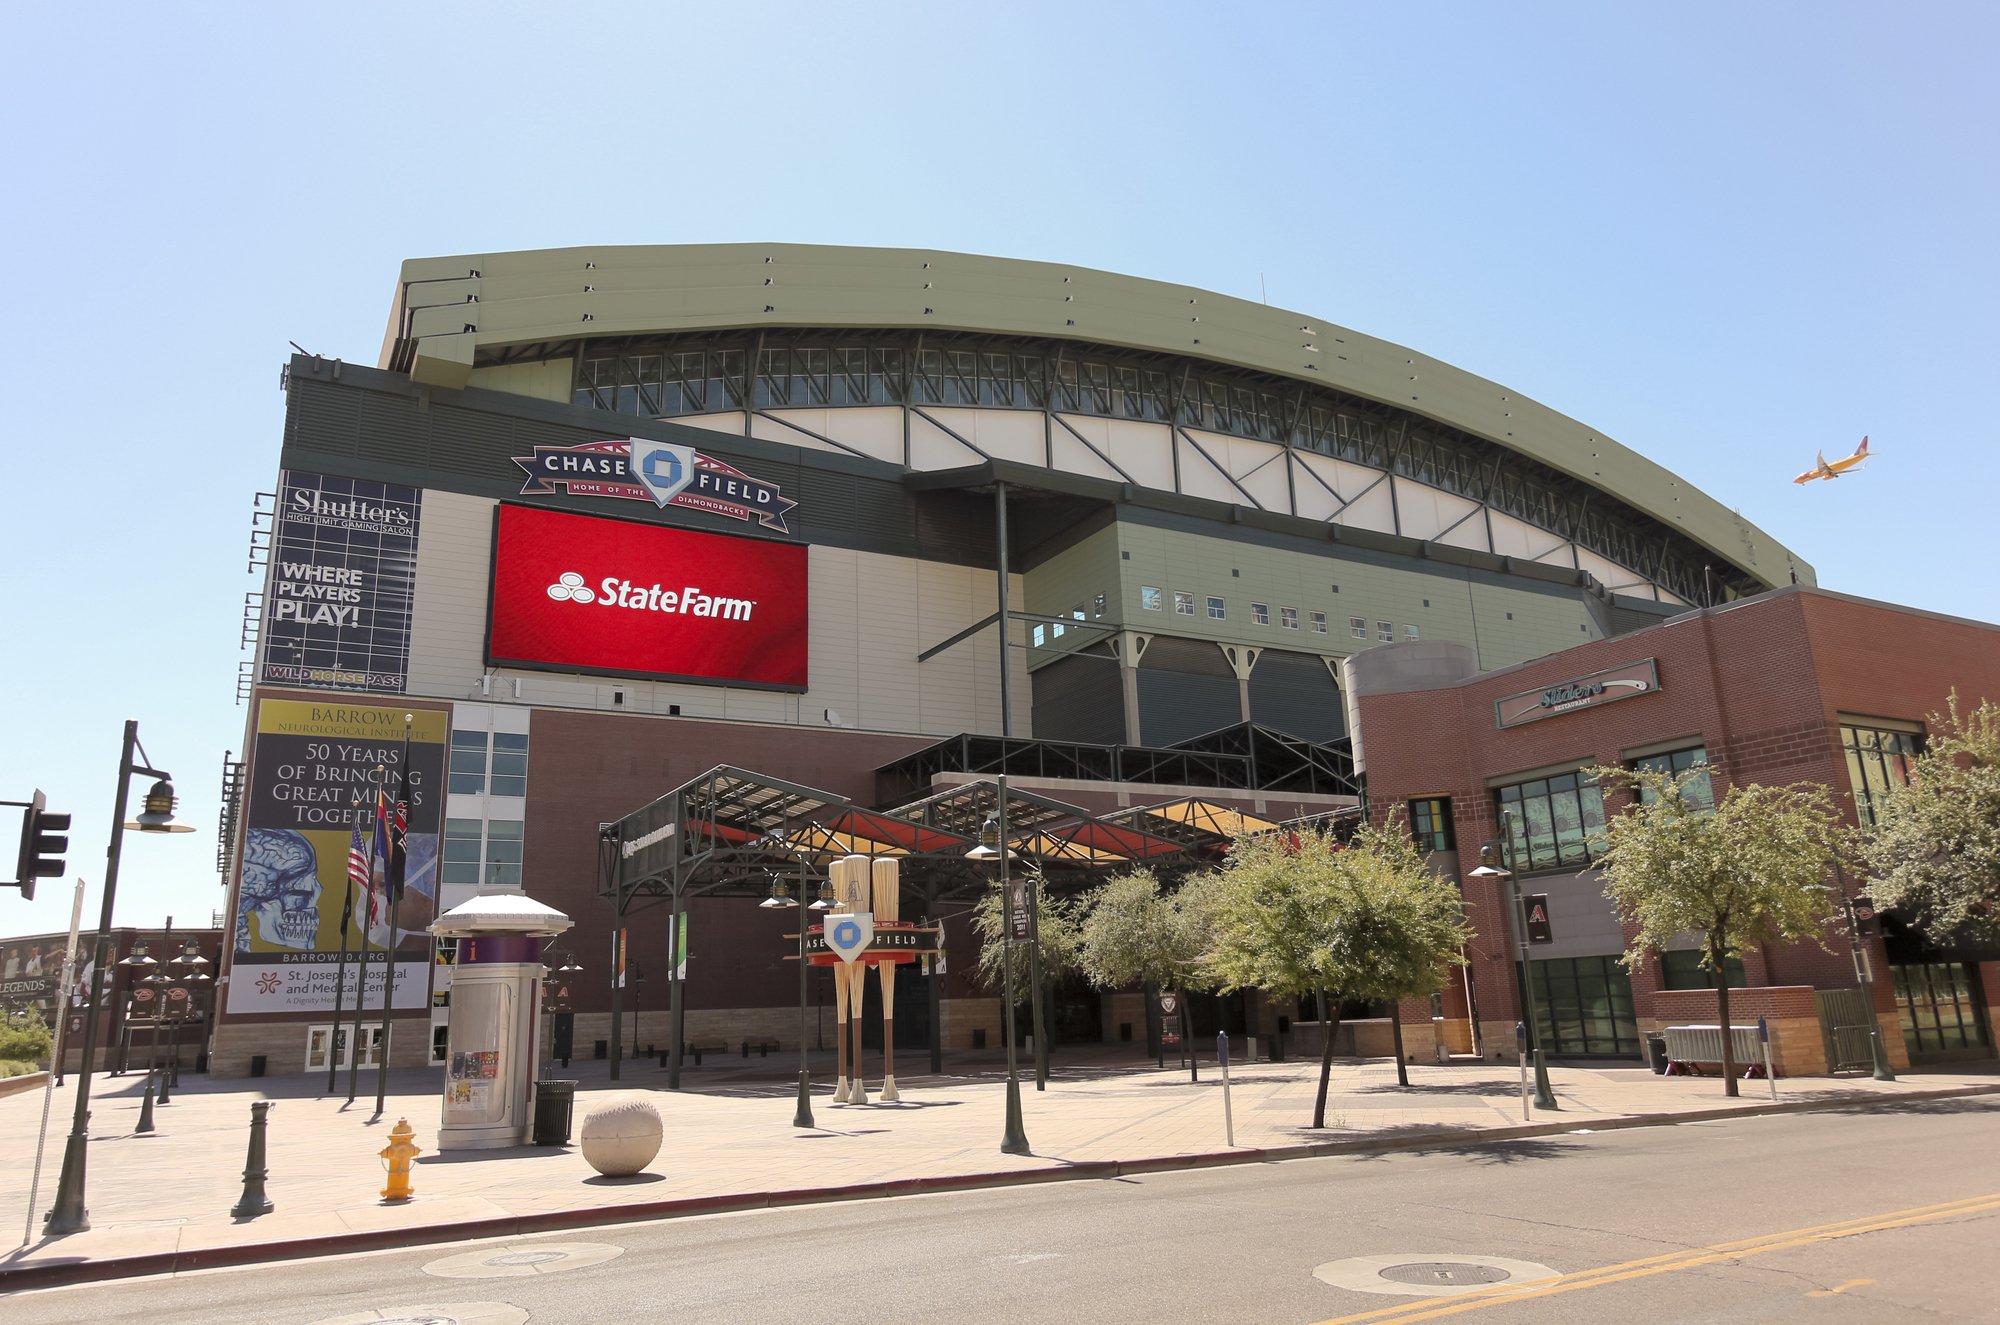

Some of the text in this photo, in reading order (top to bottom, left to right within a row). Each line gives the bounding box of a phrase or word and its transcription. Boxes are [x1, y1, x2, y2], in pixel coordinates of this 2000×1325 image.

[545, 456, 770, 504] CHASE FIELD
[292, 489, 409, 526] Shutter's
[573, 484, 601, 492] HOME
[627, 488, 644, 496] THE
[678, 496, 744, 516] DIAMONDBACKS
[287, 513, 413, 536] HIGH LIMIT GAMING SALON
[282, 562, 363, 586] WHERE
[278, 582, 361, 603] PLAYERS
[276, 599, 359, 629] PLAY!
[1554, 698, 1591, 711] RESTAURANT
[311, 708, 396, 726] BARROW
[278, 723, 366, 738] NEUROLOGICAL
[306, 744, 399, 764] 50 YEARS
[277, 765, 306, 780] OF
[273, 784, 422, 806] GREAT MINS
[293, 805, 394, 825] TOGETHE
[876, 935, 916, 945] FIELD
[283, 952, 385, 962] BARROW0.RG
[288, 970, 304, 981] St.
[363, 968, 407, 981] osptal
[286, 982, 400, 994] and Medcal Cenr
[293, 997, 319, 1006] Dignity
